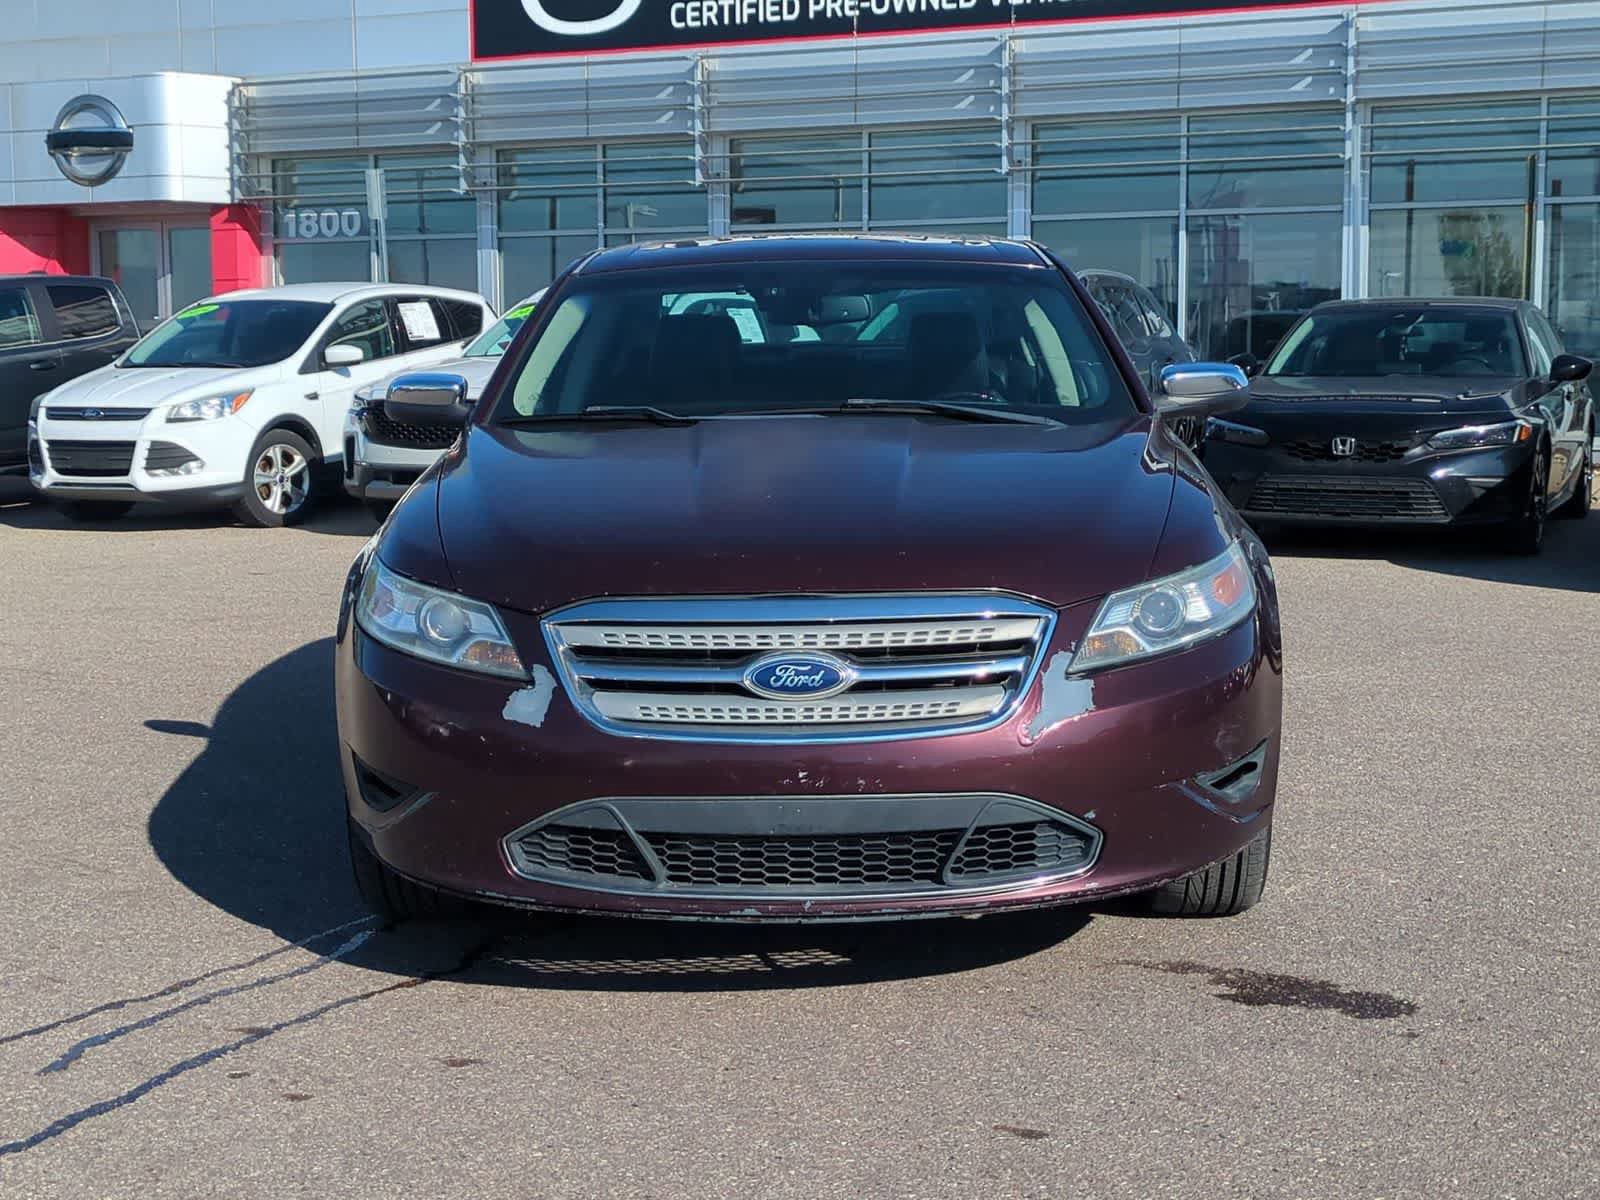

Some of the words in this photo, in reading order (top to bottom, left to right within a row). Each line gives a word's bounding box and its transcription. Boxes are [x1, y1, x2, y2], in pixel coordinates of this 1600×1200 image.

[670, 0, 800, 28] CERTIFIED
[284, 208, 361, 238] 1800
[769, 664, 825, 688] Ford
